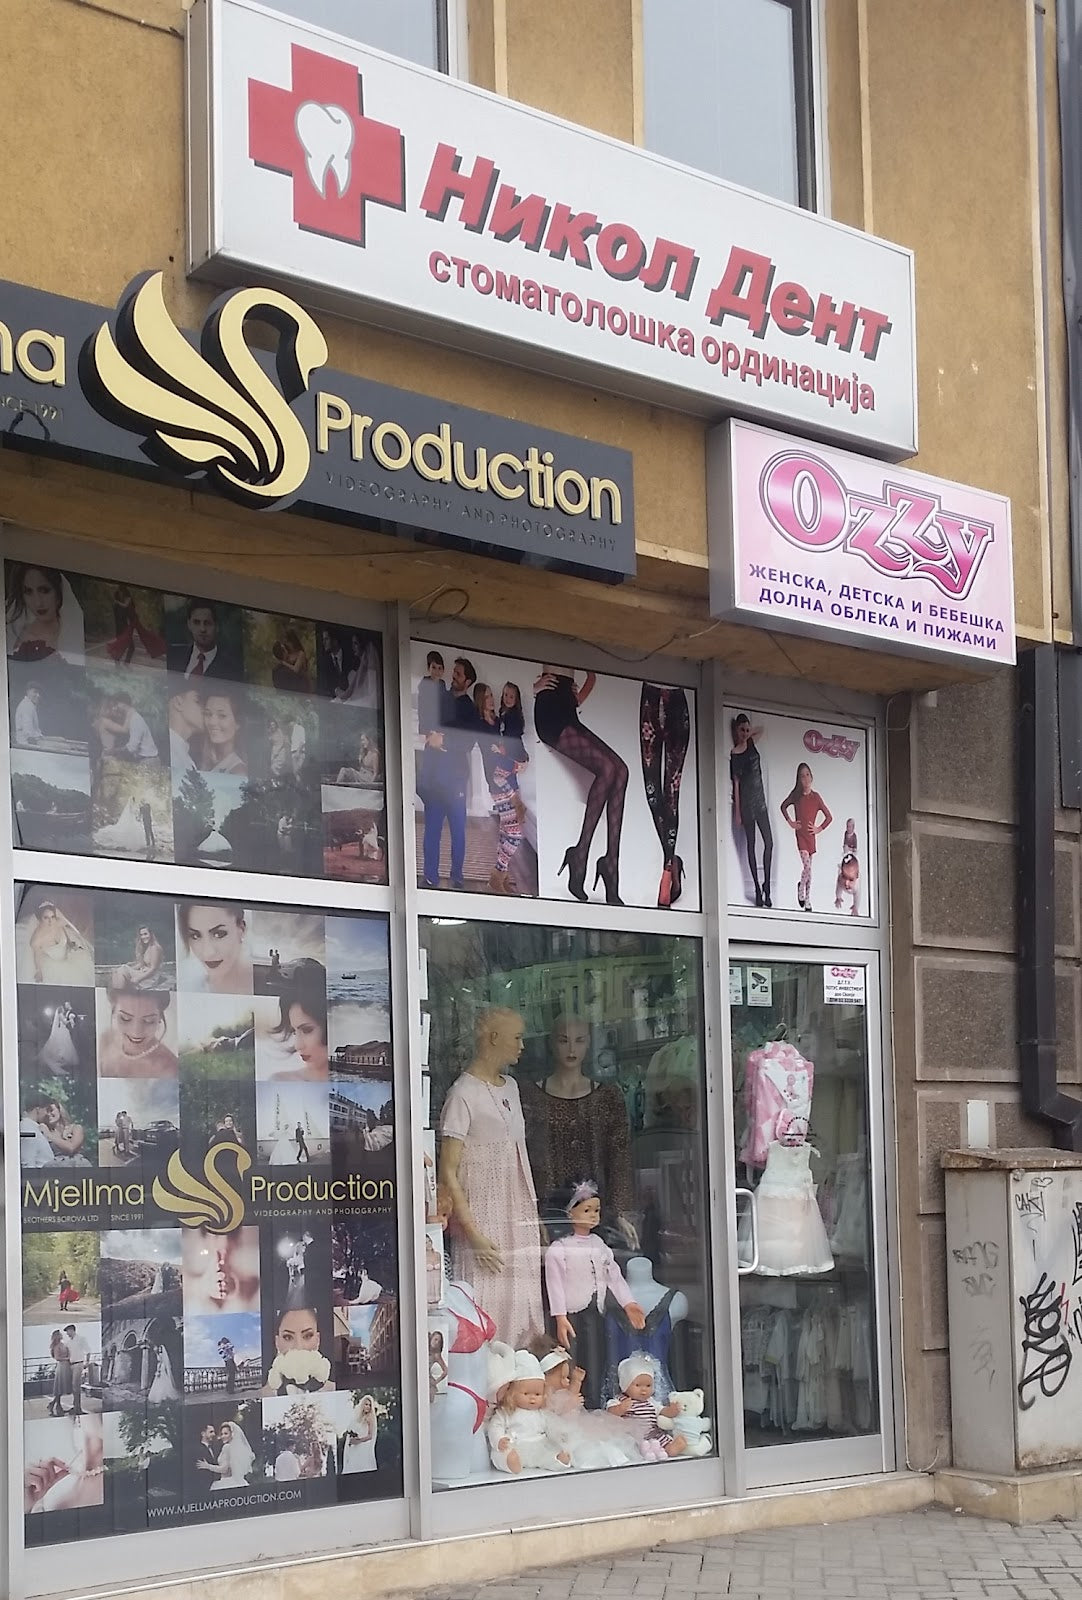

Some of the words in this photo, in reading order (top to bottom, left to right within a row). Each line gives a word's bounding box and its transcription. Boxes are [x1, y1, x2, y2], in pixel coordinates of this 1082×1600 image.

[420, 142, 698, 300] Никол
[705, 245, 892, 361] Дент
[428, 250, 695, 359] стоматолошка
[701, 336, 875, 413] ординација
[315, 391, 623, 527] Production
[326, 470, 452, 513] VIDEOGRAPHY
[461, 505, 496, 524] AND
[499, 513, 617, 552] PHOTOGRAPHY
[749, 563, 833, 597] ЖЕНСКА,
[839, 584, 905, 611] ДЕТСКА
[911, 600, 922, 614] И
[928, 605, 1004, 633] БЕБЕШКА
[759, 588, 824, 614] ДОЛНА
[830, 603, 899, 629] ОБЛЕКА
[906, 620, 917, 632] И
[923, 623, 997, 650] ПИЖАМИ
[24, 1178, 145, 1212] Mjellma
[251, 1174, 394, 1202] Production
[254, 1209, 313, 1217] VIDEOGRAPHY
[334, 1207, 392, 1215] PHOTOGRAPHY
[87, 1214, 99, 1222] LTD
[110, 1213, 130, 1222] SINCE
[131, 1213, 144, 1221] 1991
[147, 1490, 302, 1518] WWW.MJELLMAPRODUCTION.COM
